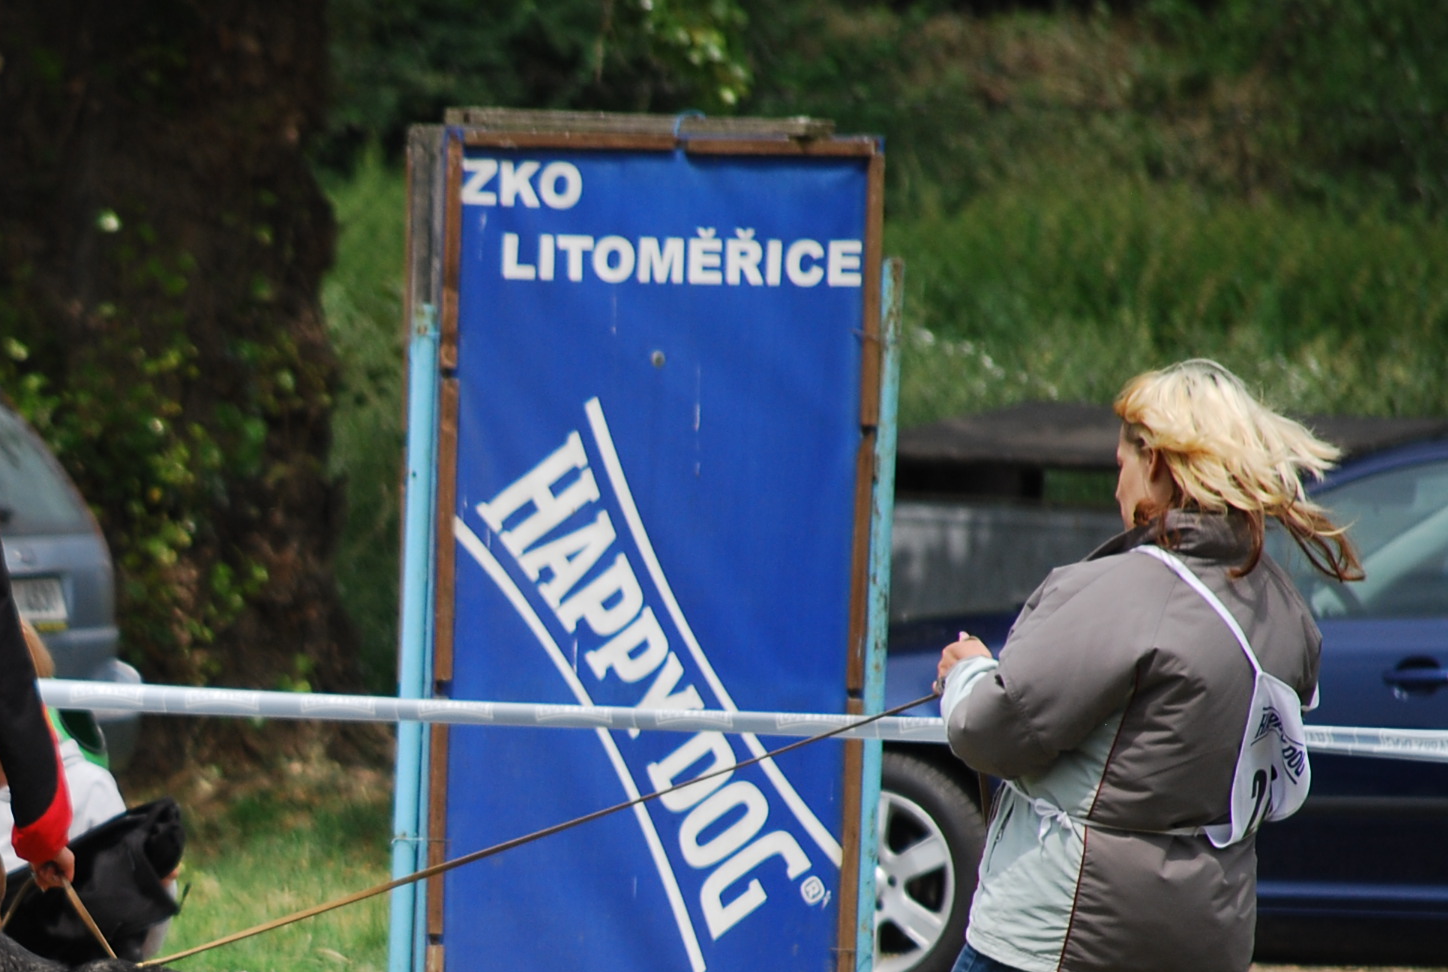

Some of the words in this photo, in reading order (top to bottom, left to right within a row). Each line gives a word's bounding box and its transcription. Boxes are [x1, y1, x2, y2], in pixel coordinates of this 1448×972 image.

[460, 158, 583, 210] ZKO
[501, 227, 863, 287] LITOMĚŘICE
[476, 429, 706, 740] HAPPY
[647, 729, 813, 941] DOG
[1242, 764, 1279, 838] 2
